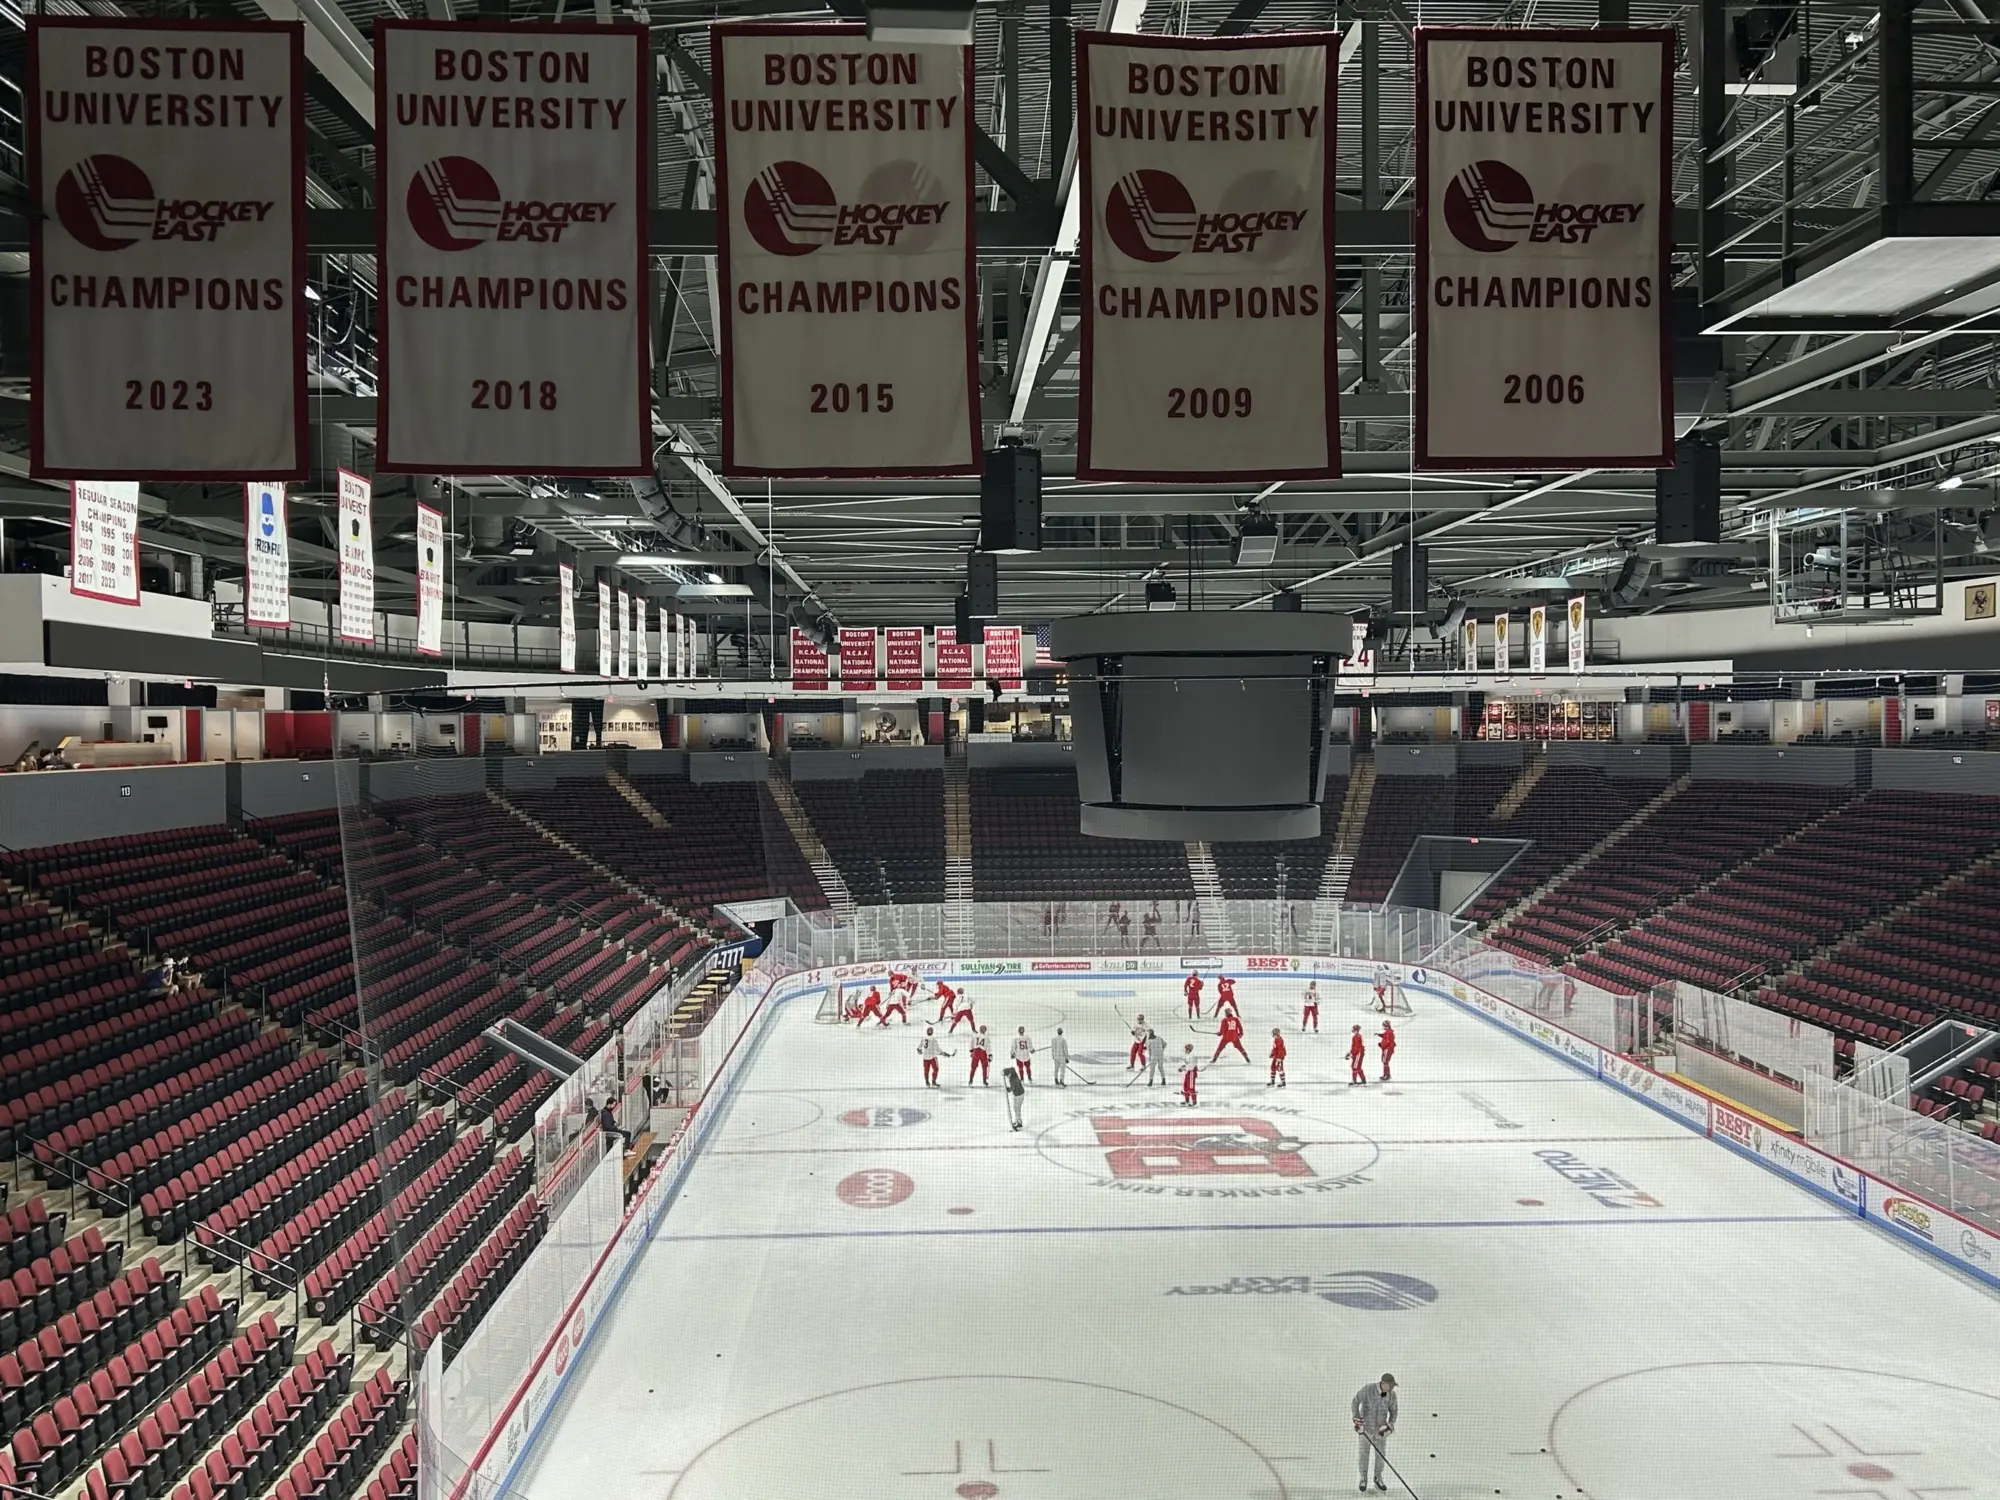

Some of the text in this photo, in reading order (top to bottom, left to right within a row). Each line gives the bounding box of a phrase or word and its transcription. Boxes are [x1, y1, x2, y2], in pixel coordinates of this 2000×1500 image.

[86, 46, 244, 81] BOSTON
[435, 49, 589, 83] BOSTON
[765, 53, 916, 85] BOSTON
[1467, 56, 1614, 89] BOSTON
[1128, 63, 1278, 96] BOSTON
[45, 92, 283, 128] UNIVERSITY
[396, 94, 627, 130] UNIVERSITY
[731, 96, 957, 131] UNIVERSITY
[1096, 106, 1319, 142] UNIVERSITY
[1434, 100, 1654, 133] UNIVERSITY
[156, 199, 274, 223] HOCKEY
[502, 200, 617, 222] HOCKEY
[839, 201, 950, 225] HOCKEY
[1197, 210, 1306, 232] HOCKEY
[1533, 203, 1644, 224] HOCKEY
[151, 219, 225, 242] EAST
[496, 220, 569, 242] EAST
[833, 224, 903, 246] EAST
[1192, 232, 1262, 253] EAST
[1528, 223, 1598, 243] EAST
[50, 274, 283, 311] CHAMPIONS
[395, 275, 627, 311] CHAMPIONS
[739, 277, 961, 314] CHAMPIONS
[1099, 284, 1318, 319] CHAMPIONS
[1434, 276, 1651, 308] CHAMPIONS
[126, 380, 213, 411] 2023
[471, 379, 557, 410] 2018
[811, 383, 893, 413] 2015
[1168, 387, 1251, 419] 2009
[1503, 374, 1584, 405] 2006
[110, 497, 137, 514] SEASON
[121, 786, 131, 796] 113
[961, 962, 1021, 971] SULLIVAN TIRE
[1247, 958, 1289, 967] BEST
[1190, 979, 1195, 988] 2
[923, 1038, 929, 1049] 3
[976, 1037, 985, 1047] 14
[1019, 1040, 1028, 1050] 61
[1716, 1107, 1752, 1140] BEST
[1771, 1138, 1826, 1178] xfinity mobile
[1089, 1173, 1374, 1198] JACK PARKER RINK
